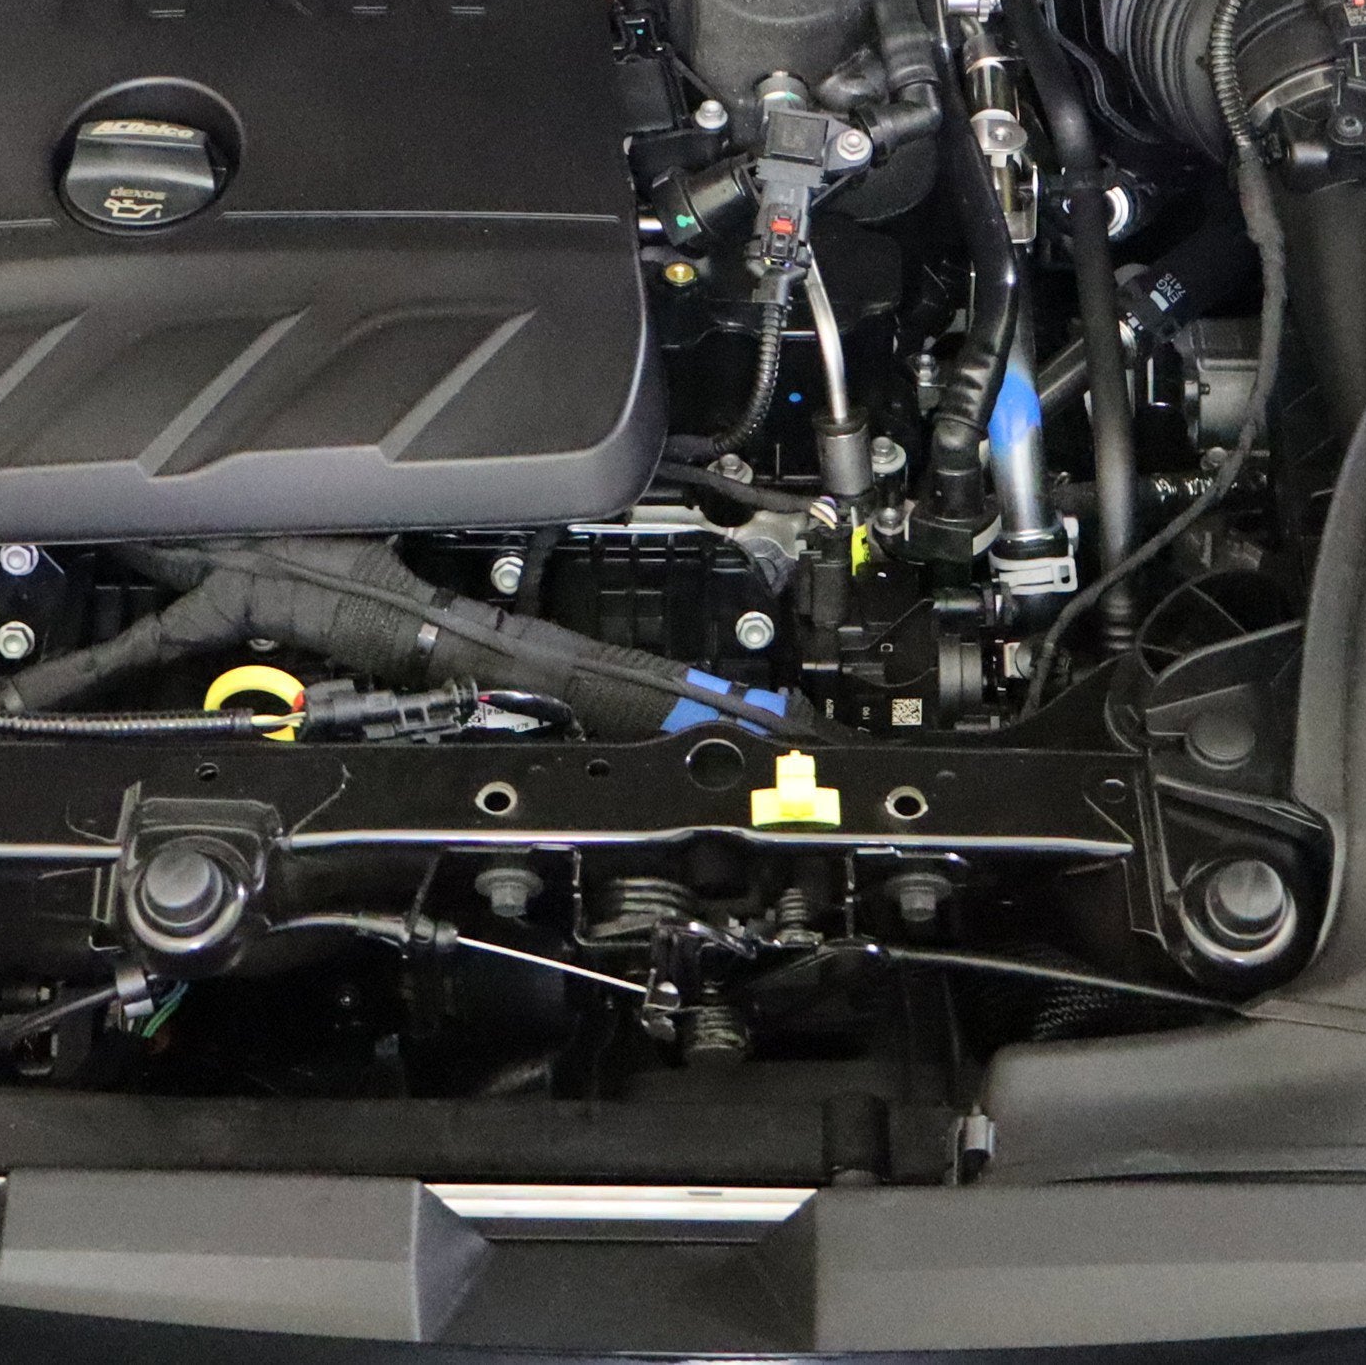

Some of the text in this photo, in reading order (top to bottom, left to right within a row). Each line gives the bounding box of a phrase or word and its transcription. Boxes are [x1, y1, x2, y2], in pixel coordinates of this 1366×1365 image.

[91, 121, 195, 138] ACDelco
[110, 187, 166, 200] dexos
[1156, 279, 1180, 303] ENG
